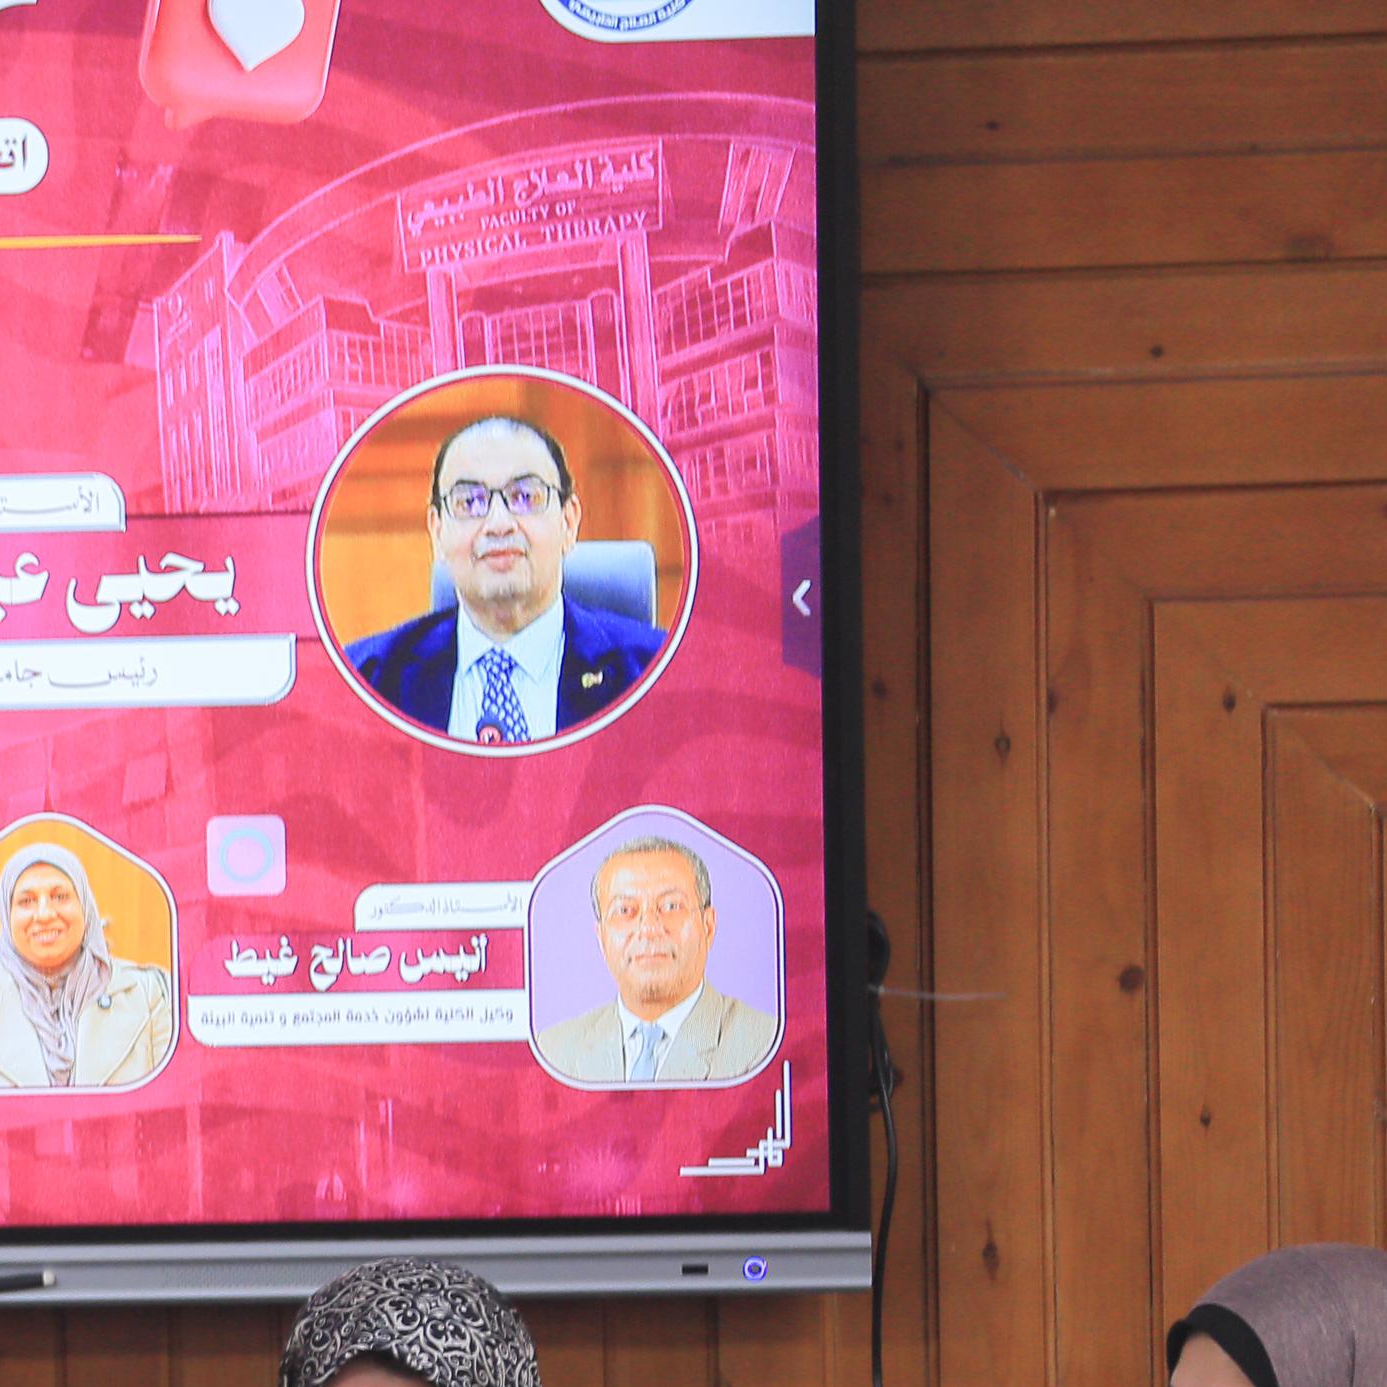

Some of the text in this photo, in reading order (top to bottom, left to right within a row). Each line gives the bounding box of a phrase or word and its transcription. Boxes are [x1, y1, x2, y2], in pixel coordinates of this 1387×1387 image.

[419, 209, 648, 269] PHYSICAL THERAPY
[480, 200, 577, 231] FACULTY OF
[65, 551, 240, 633] يحيى
[48, 656, 158, 689] رئيس
[224, 935, 299, 986] غيط
[309, 936, 392, 991] صالح
